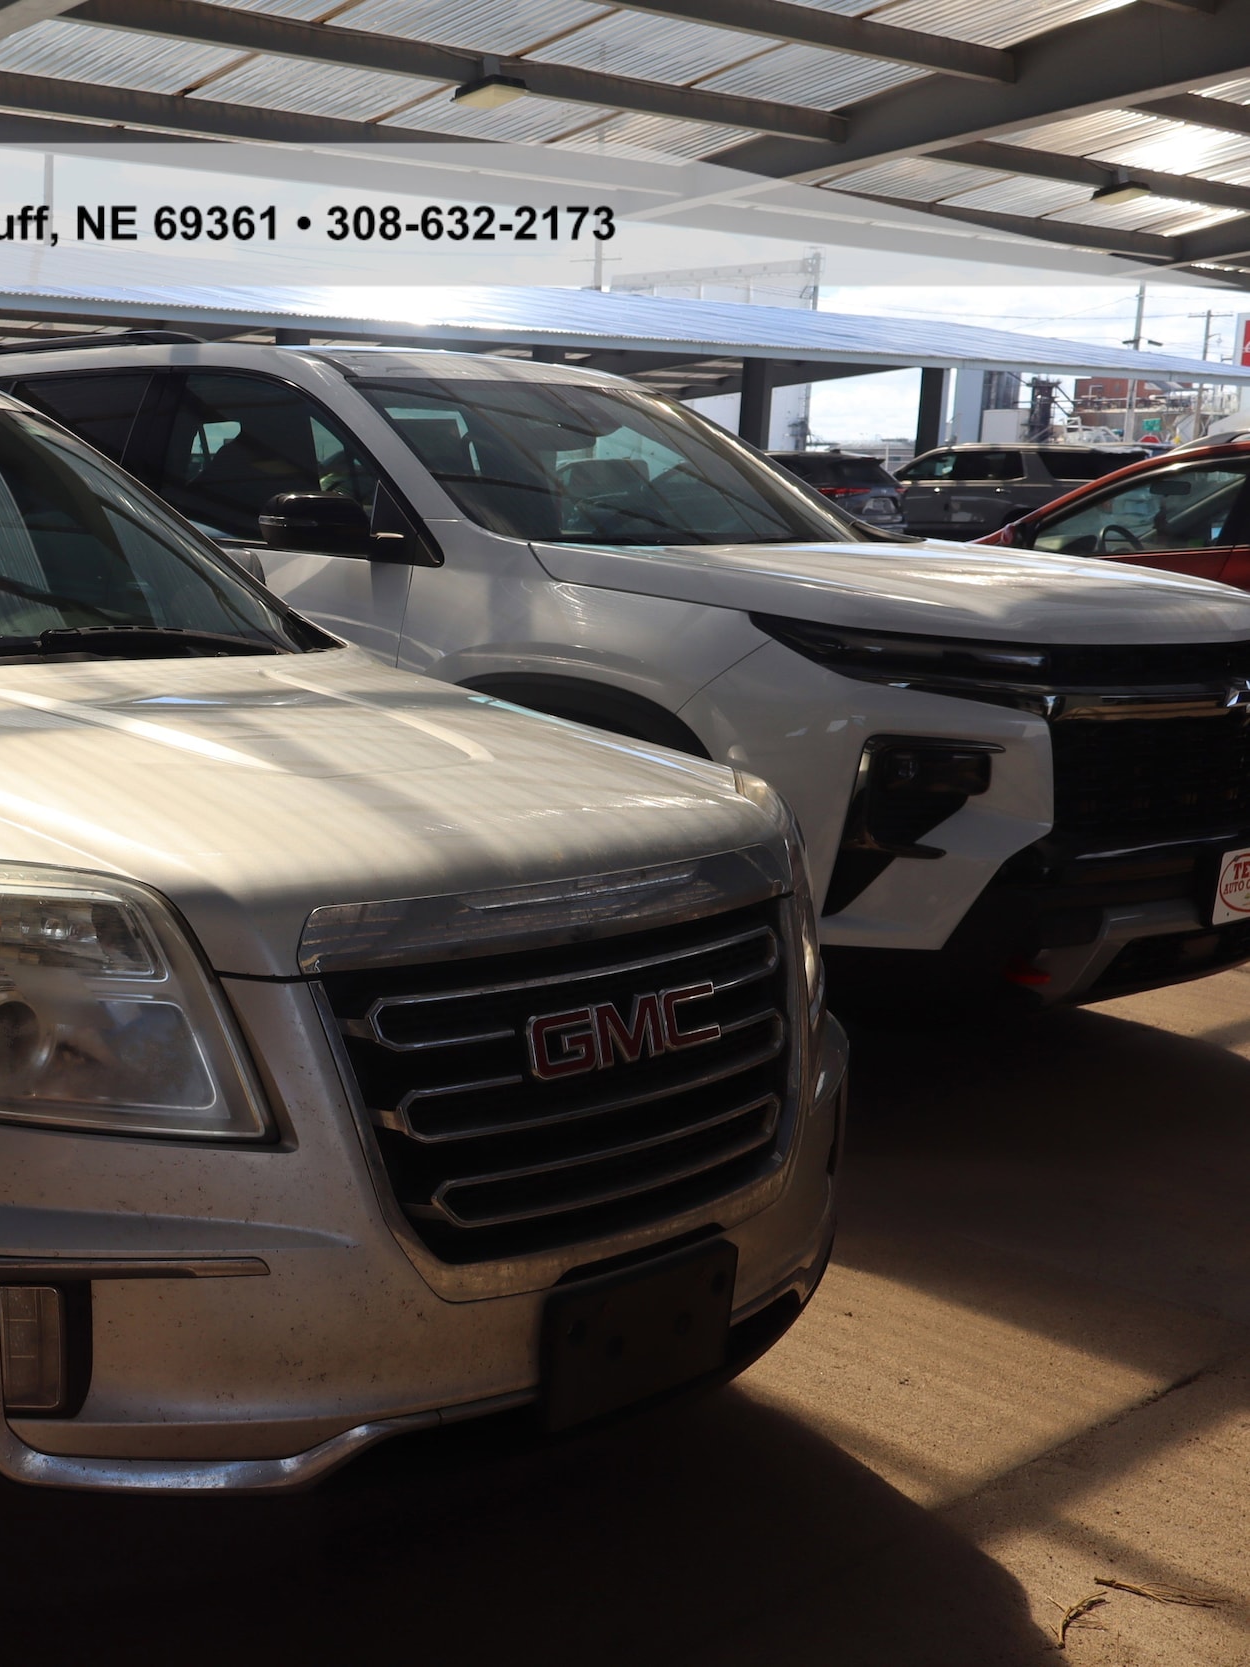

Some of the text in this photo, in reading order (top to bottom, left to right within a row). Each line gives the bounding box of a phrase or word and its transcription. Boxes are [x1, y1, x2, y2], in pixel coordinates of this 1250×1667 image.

[1234, 861, 1250, 880] TE
[1223, 880, 1244, 895] AUTO
[526, 981, 721, 1080] GMC
